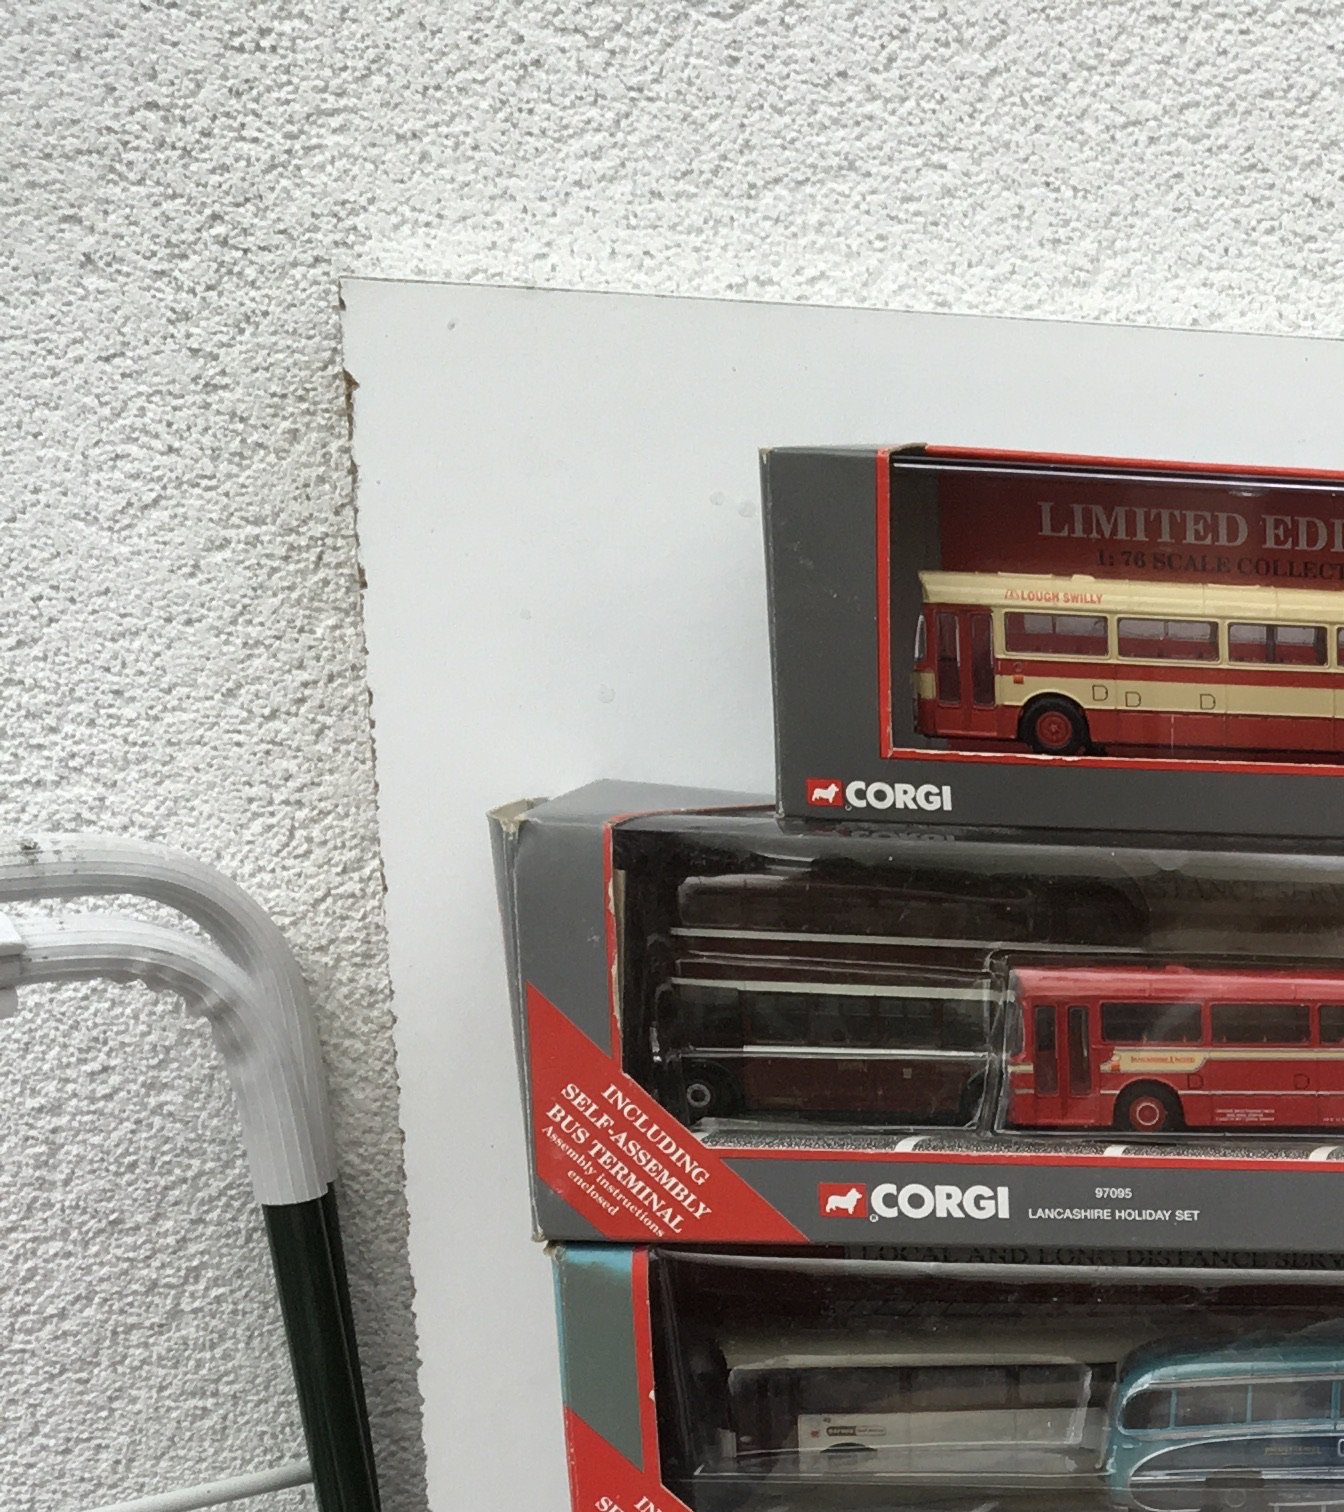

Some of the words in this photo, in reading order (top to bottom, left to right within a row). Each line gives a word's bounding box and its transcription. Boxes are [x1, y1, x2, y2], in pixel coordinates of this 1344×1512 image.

[1038, 501, 1247, 549] LIMITED
[1020, 590, 1060, 603] LOUGH
[1063, 592, 1102, 606] SWILLY
[845, 780, 952, 811] CORGI
[561, 1083, 712, 1219] SELF-ASSEMBLY
[601, 1084, 710, 1187] INCLUDING
[546, 1104, 593, 1147] BUS
[583, 1136, 685, 1234] TERMINAL
[567, 1168, 619, 1218] enclosed
[871, 1185, 1010, 1219] CORGI
[1095, 1188, 1133, 1199] 97095
[1029, 1208, 1111, 1222] LANCASHIRE
[1115, 1209, 1171, 1222] HOLIDAY
[1175, 1209, 1200, 1222] SET
